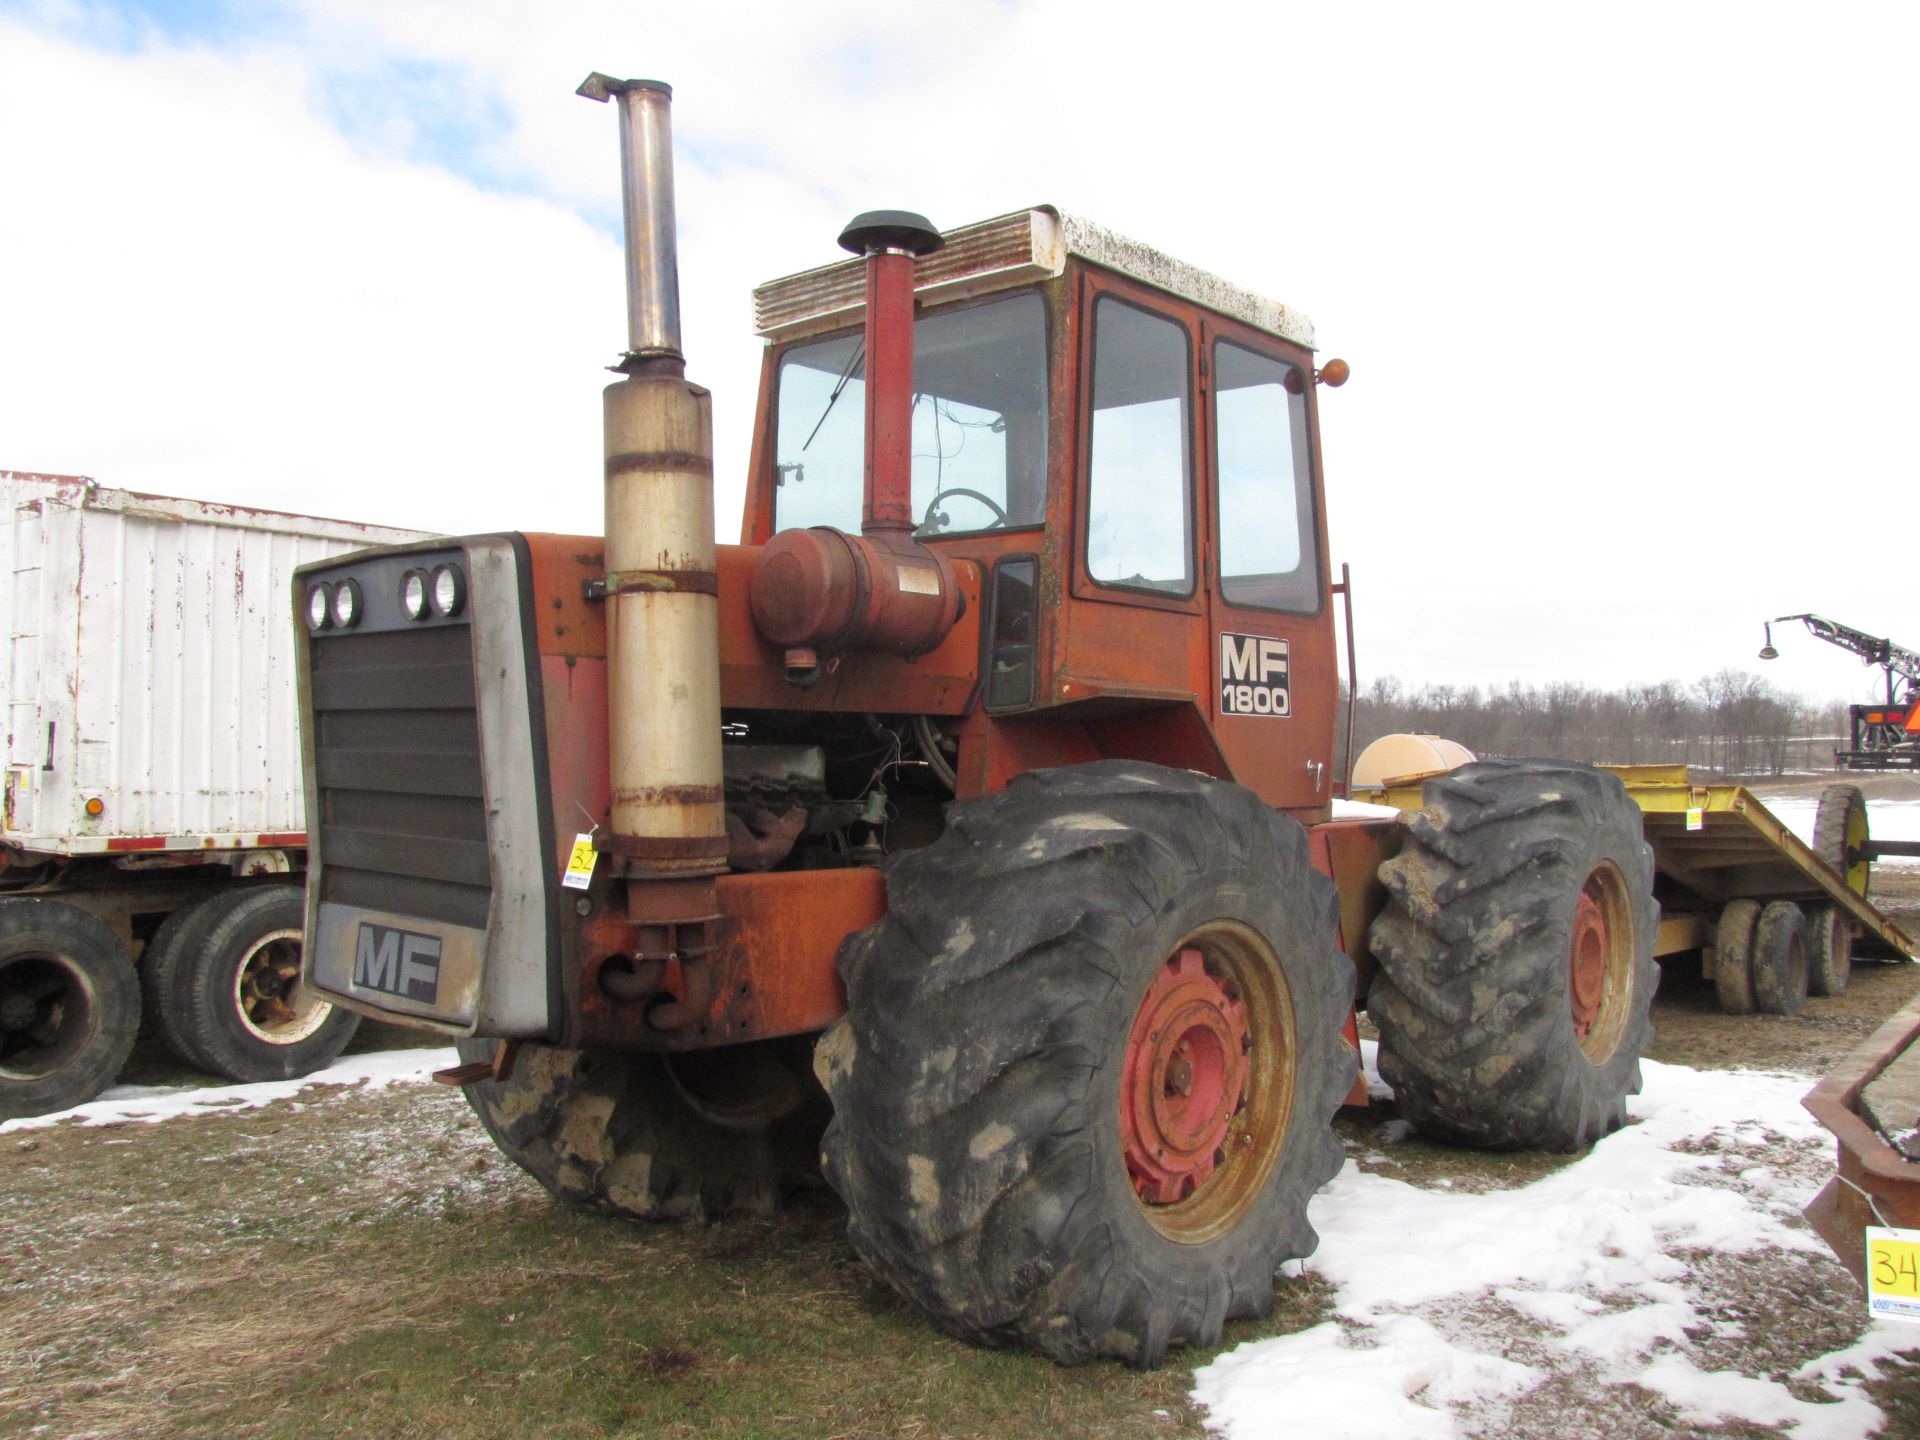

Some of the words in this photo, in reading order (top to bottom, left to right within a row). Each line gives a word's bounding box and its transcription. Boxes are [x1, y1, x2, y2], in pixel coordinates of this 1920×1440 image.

[1222, 635, 1287, 682] MF
[1223, 684, 1288, 714] 1800
[570, 848, 595, 871] 32
[355, 926, 441, 994] MF
